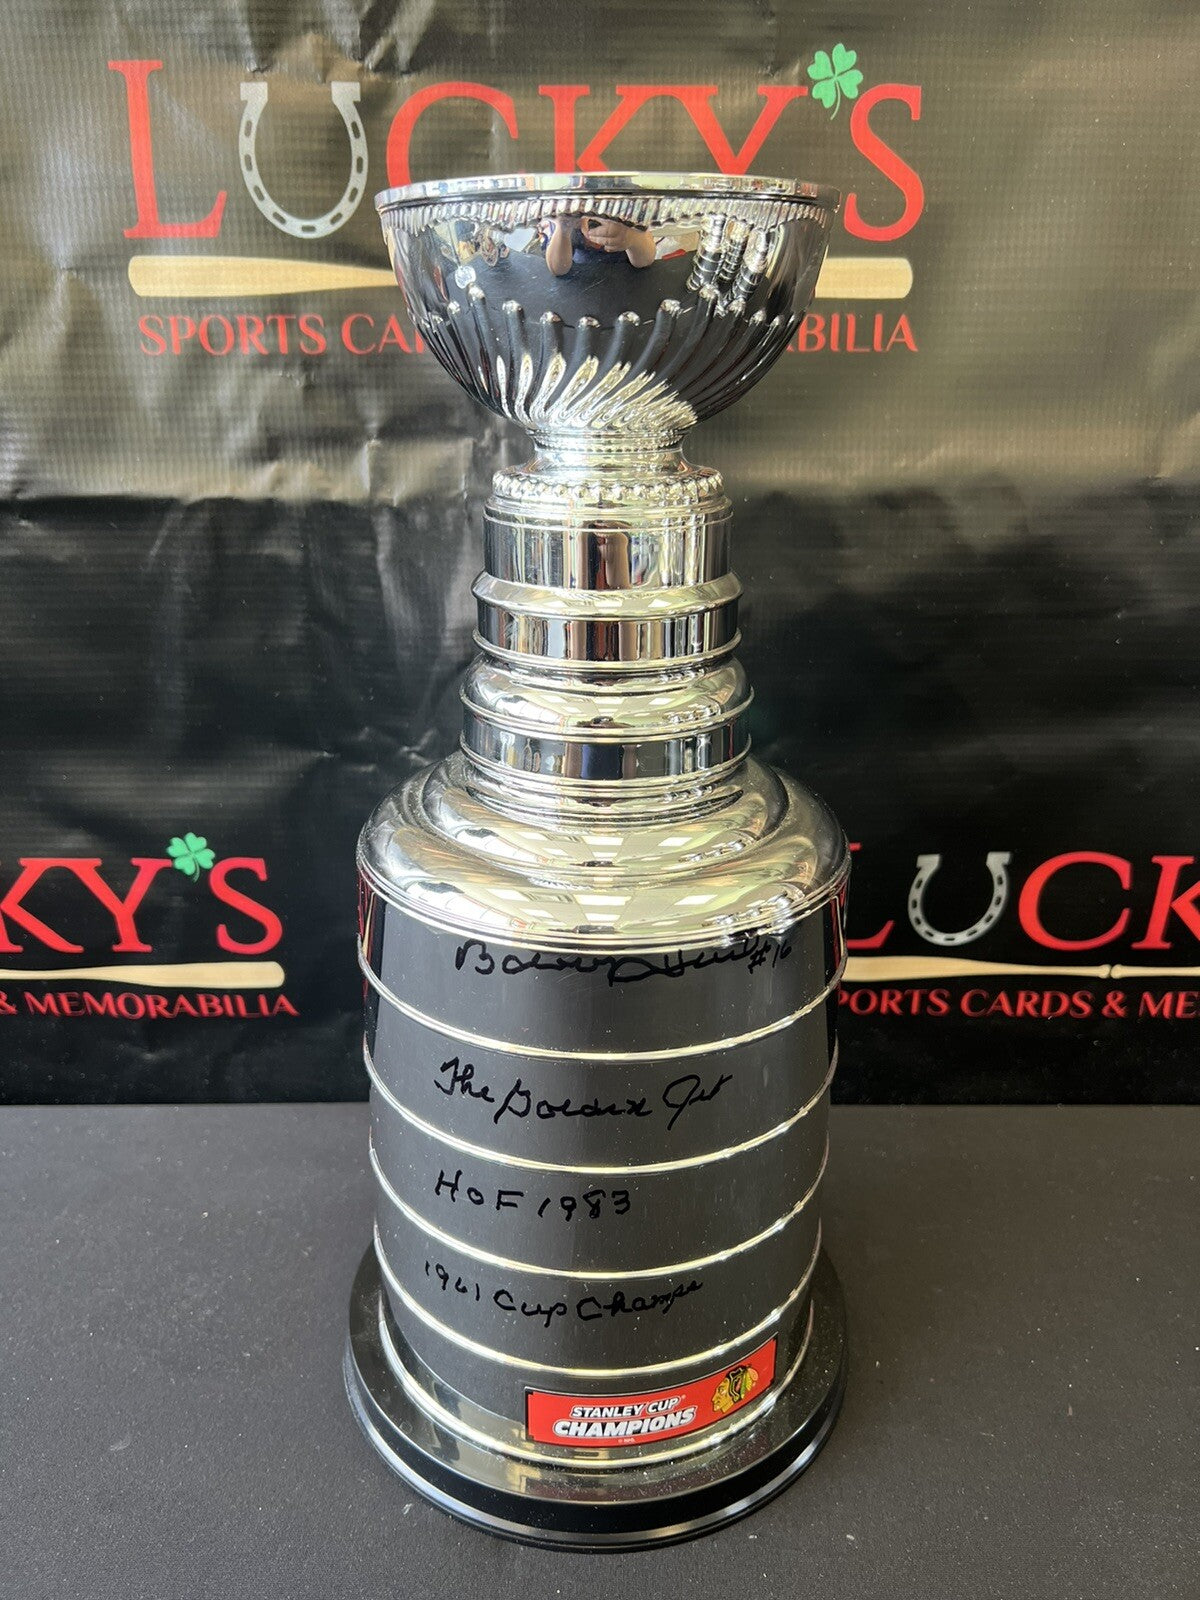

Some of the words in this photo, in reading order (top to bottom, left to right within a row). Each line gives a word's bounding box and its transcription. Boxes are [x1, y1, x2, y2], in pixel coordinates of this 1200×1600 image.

[137, 312, 328, 356] SPORTS
[24, 991, 301, 1019] MEMORABILIA
[960, 988, 1094, 1019] CARDS
[1101, 990, 1128, 1018] &
[433, 1056, 496, 1104] The
[537, 1189, 632, 1223] 1983
[424, 1259, 482, 1303] 1961
[492, 1287, 568, 1329] Cup
[554, 1406, 697, 1438] CHAMPIONS
[571, 1401, 645, 1420] STANLEY
